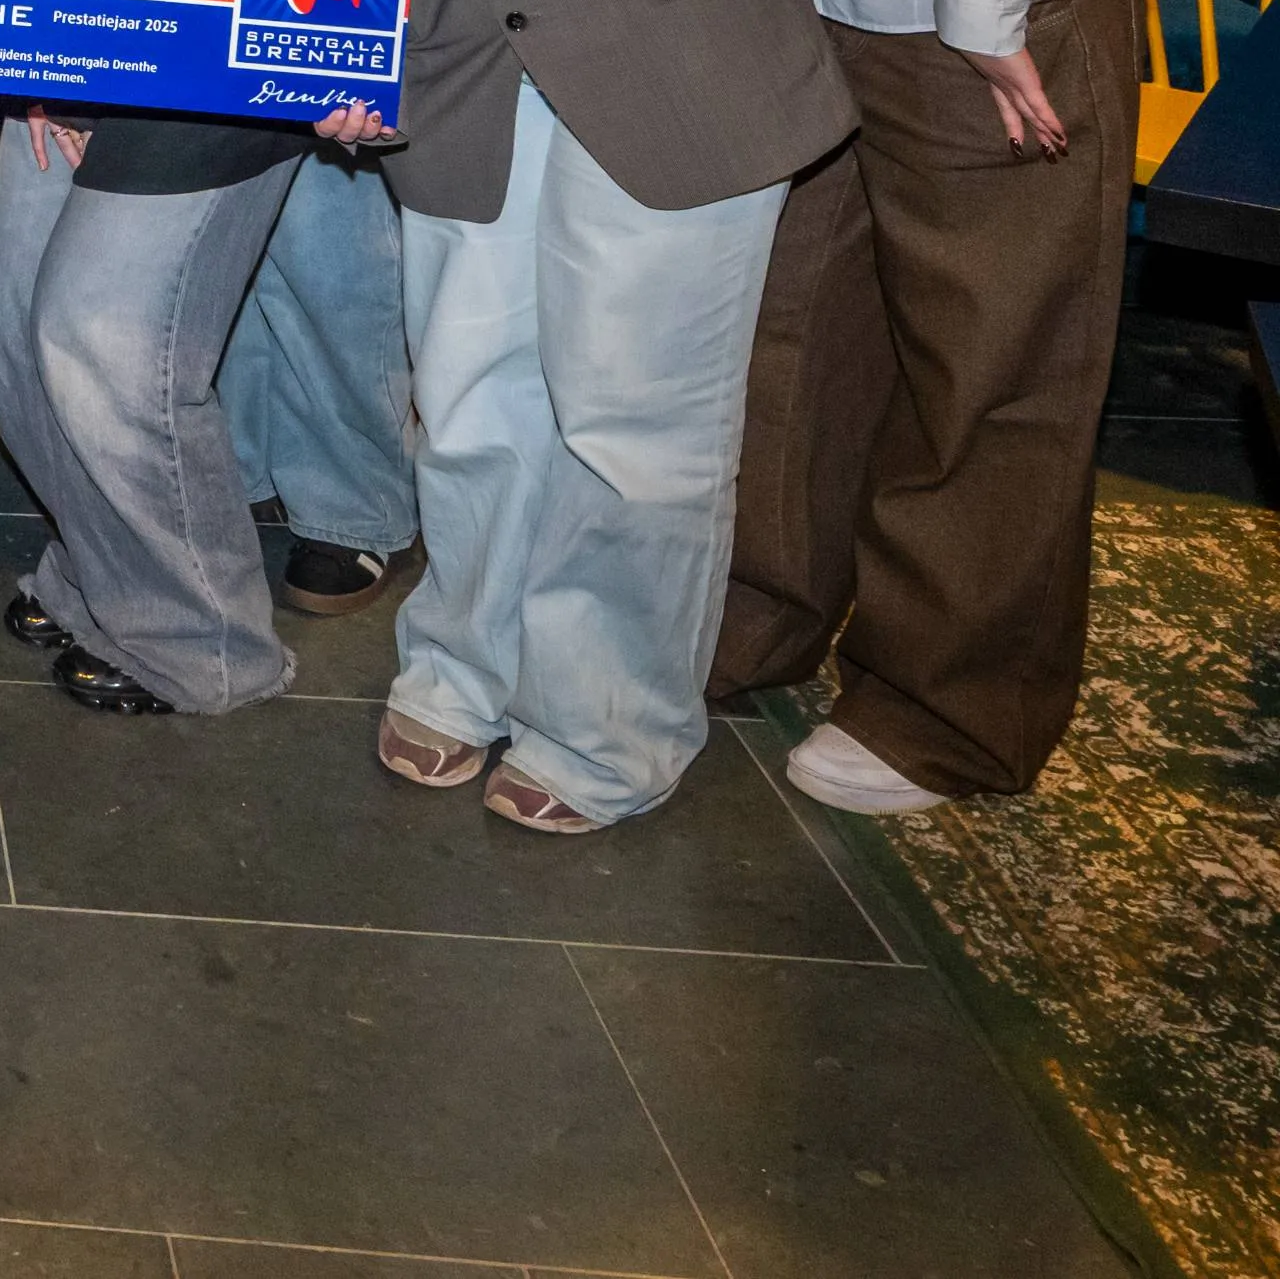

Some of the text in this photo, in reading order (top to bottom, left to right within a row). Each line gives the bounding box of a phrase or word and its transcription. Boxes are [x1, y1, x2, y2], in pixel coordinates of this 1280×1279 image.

[53, 10, 141, 31] Prestatiejaar
[145, 19, 178, 33] 2025
[246, 31, 385, 53] SPORTGALA
[35, 51, 54, 64] het
[57, 54, 110, 70] Sportgala
[112, 59, 157, 73] Drenthe
[245, 44, 385, 68] DRENTHE
[29, 70, 40, 79] in
[43, 70, 87, 84] Emmen.
